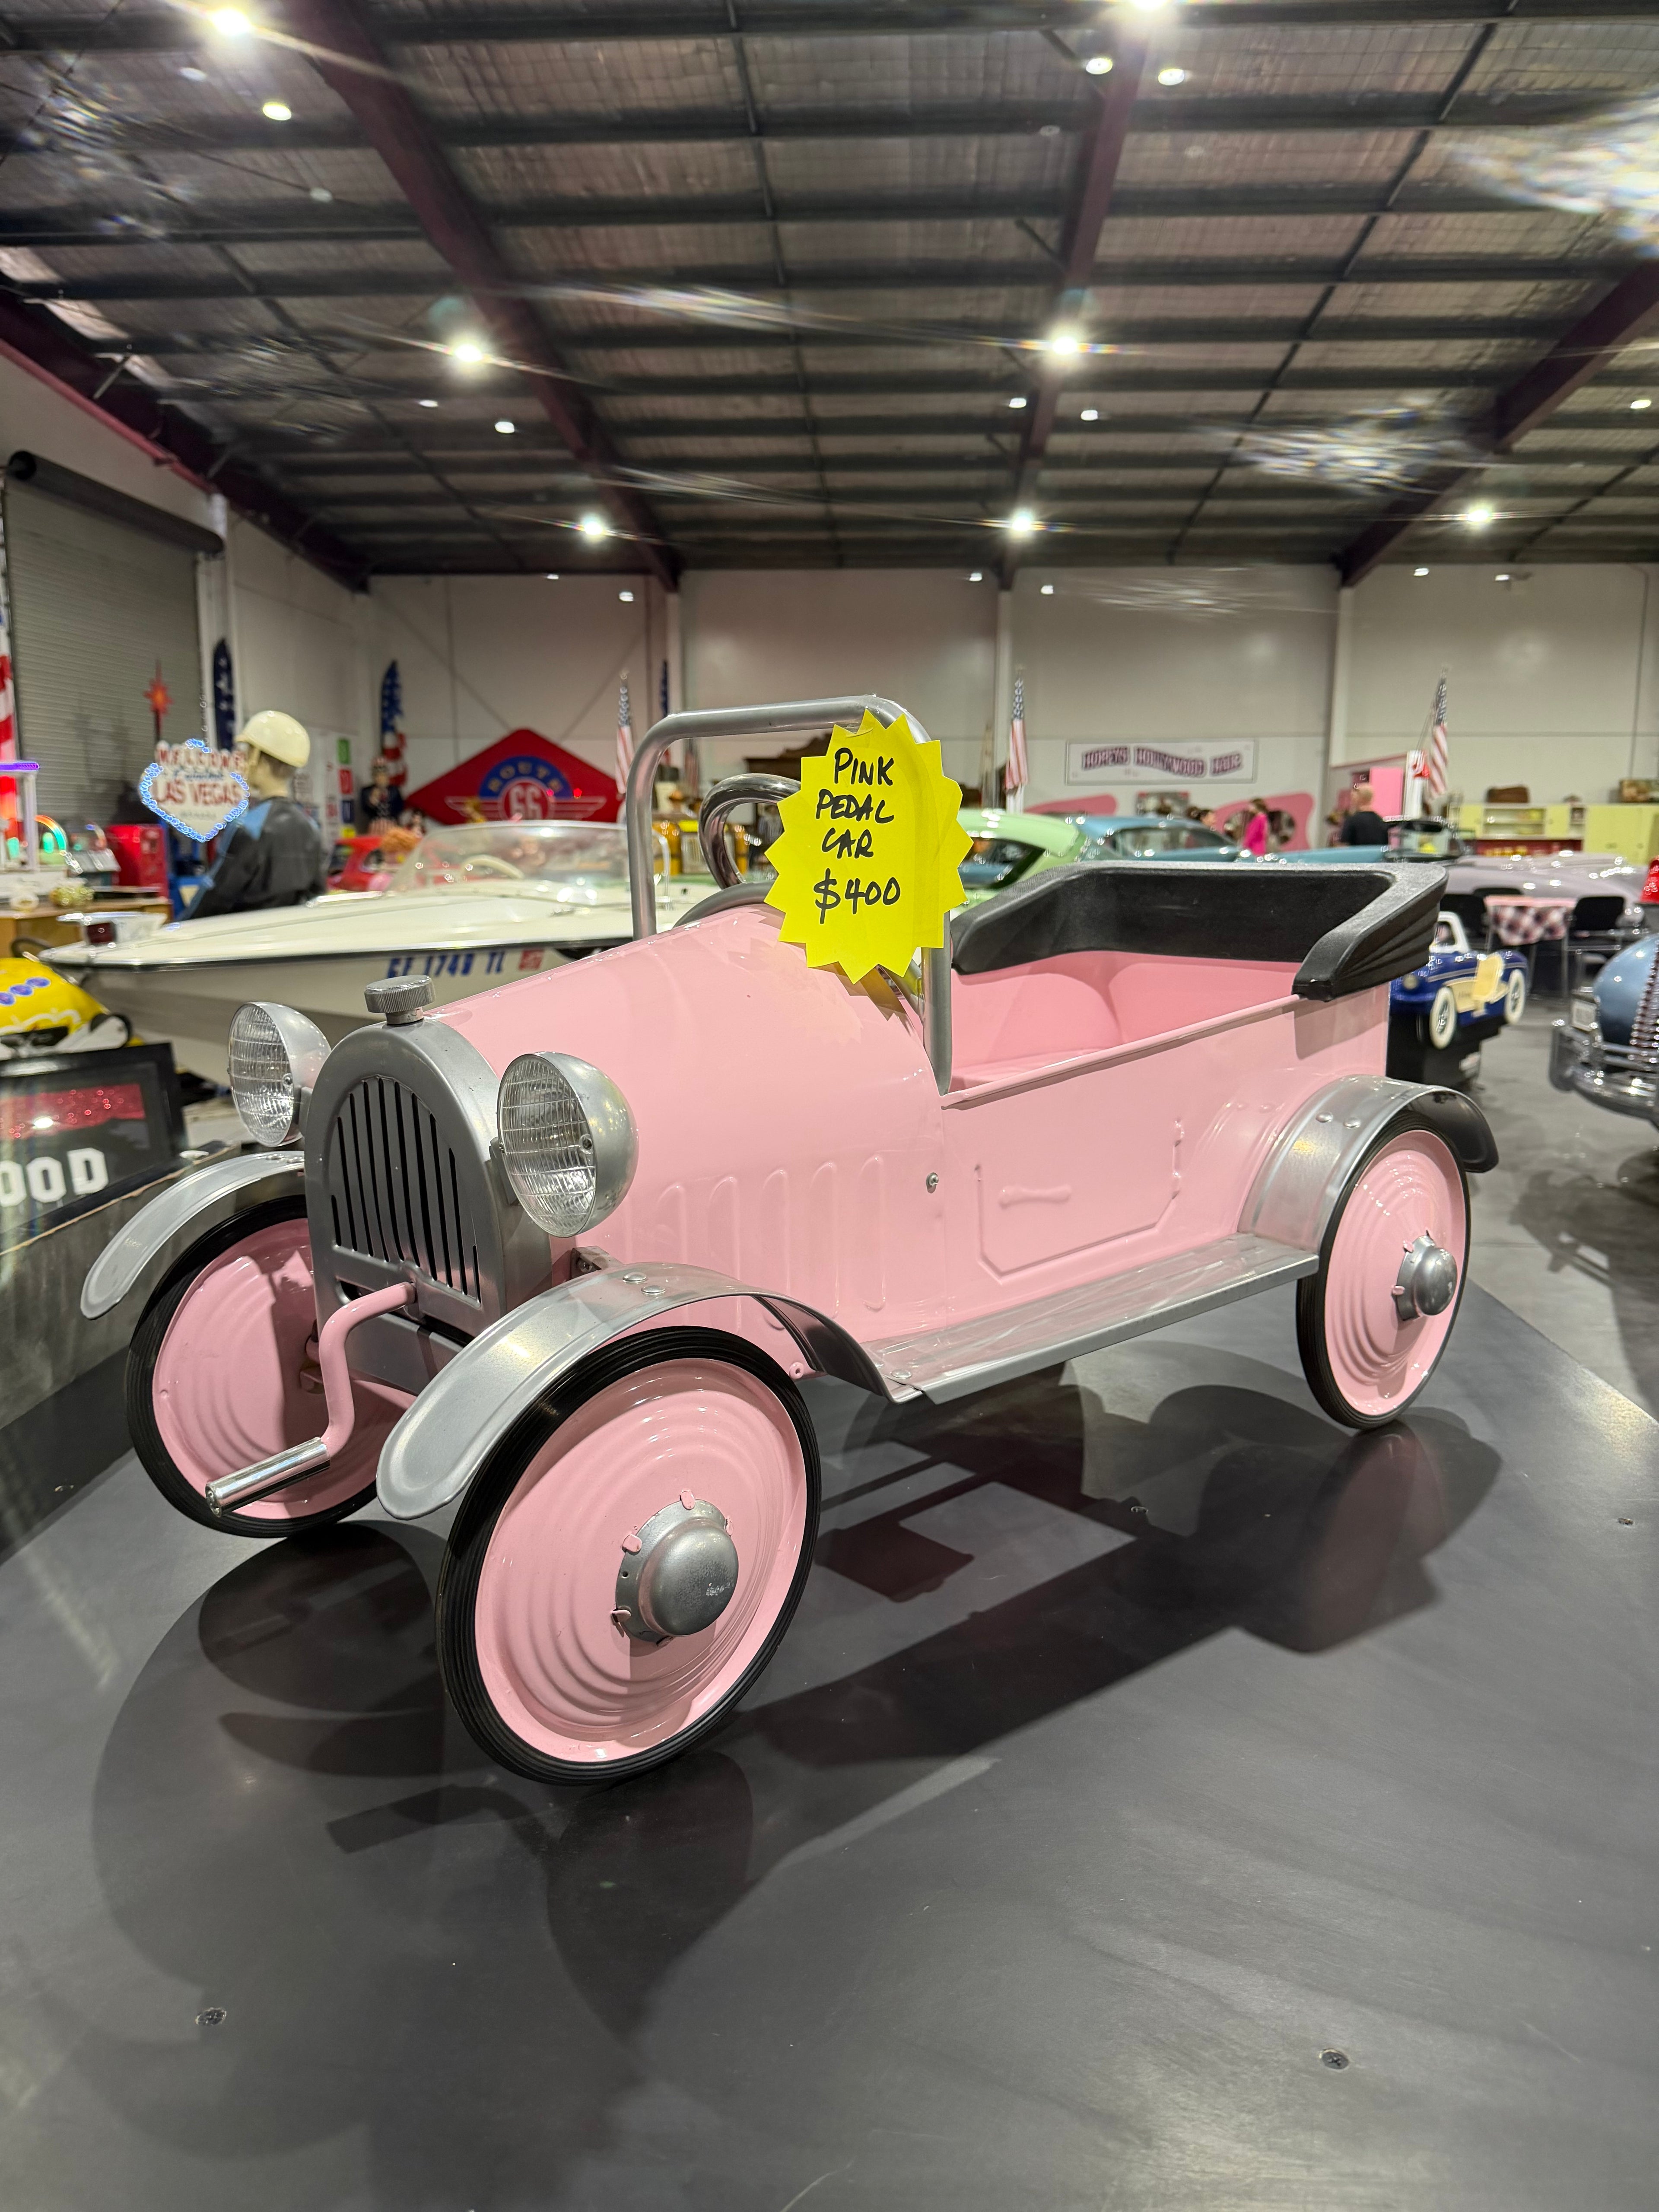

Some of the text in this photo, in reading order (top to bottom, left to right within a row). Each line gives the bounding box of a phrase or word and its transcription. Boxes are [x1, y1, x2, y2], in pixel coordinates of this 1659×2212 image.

[159, 748, 247, 767] WELCOME
[834, 747, 894, 786] PINK
[151, 779, 243, 805] LAS VEGAS
[488, 761, 563, 793] ROUTE
[509, 785, 543, 820] 66
[816, 789, 895, 823] PEDAL
[822, 827, 874, 859] CAR
[814, 868, 901, 925] $400
